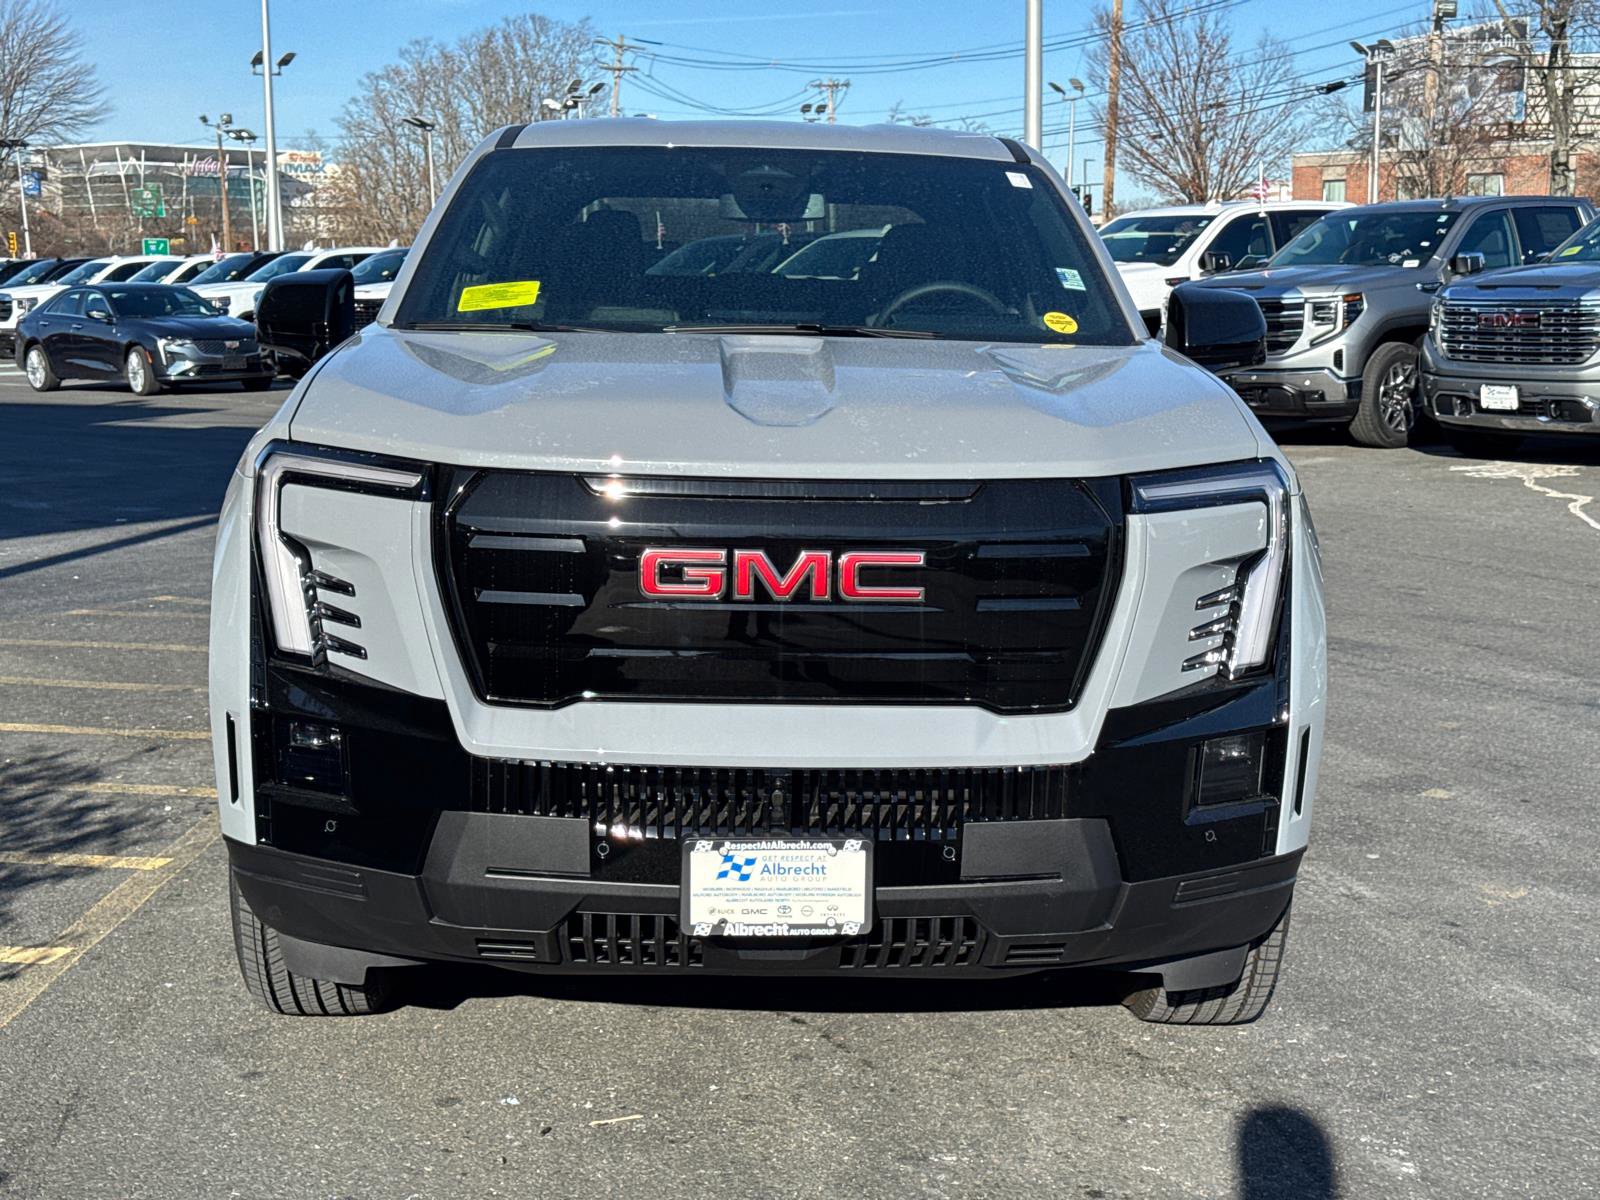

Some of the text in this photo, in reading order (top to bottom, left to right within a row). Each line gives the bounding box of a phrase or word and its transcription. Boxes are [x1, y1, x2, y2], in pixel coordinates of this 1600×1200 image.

[284, 163, 326, 174] IMAX
[638, 548, 927, 602] GMC
[724, 840, 833, 852] RespectAtAlbrecht.com
[760, 863, 827, 875] Albrecht
[723, 922, 838, 936] Albrecht AUTO GROUP
